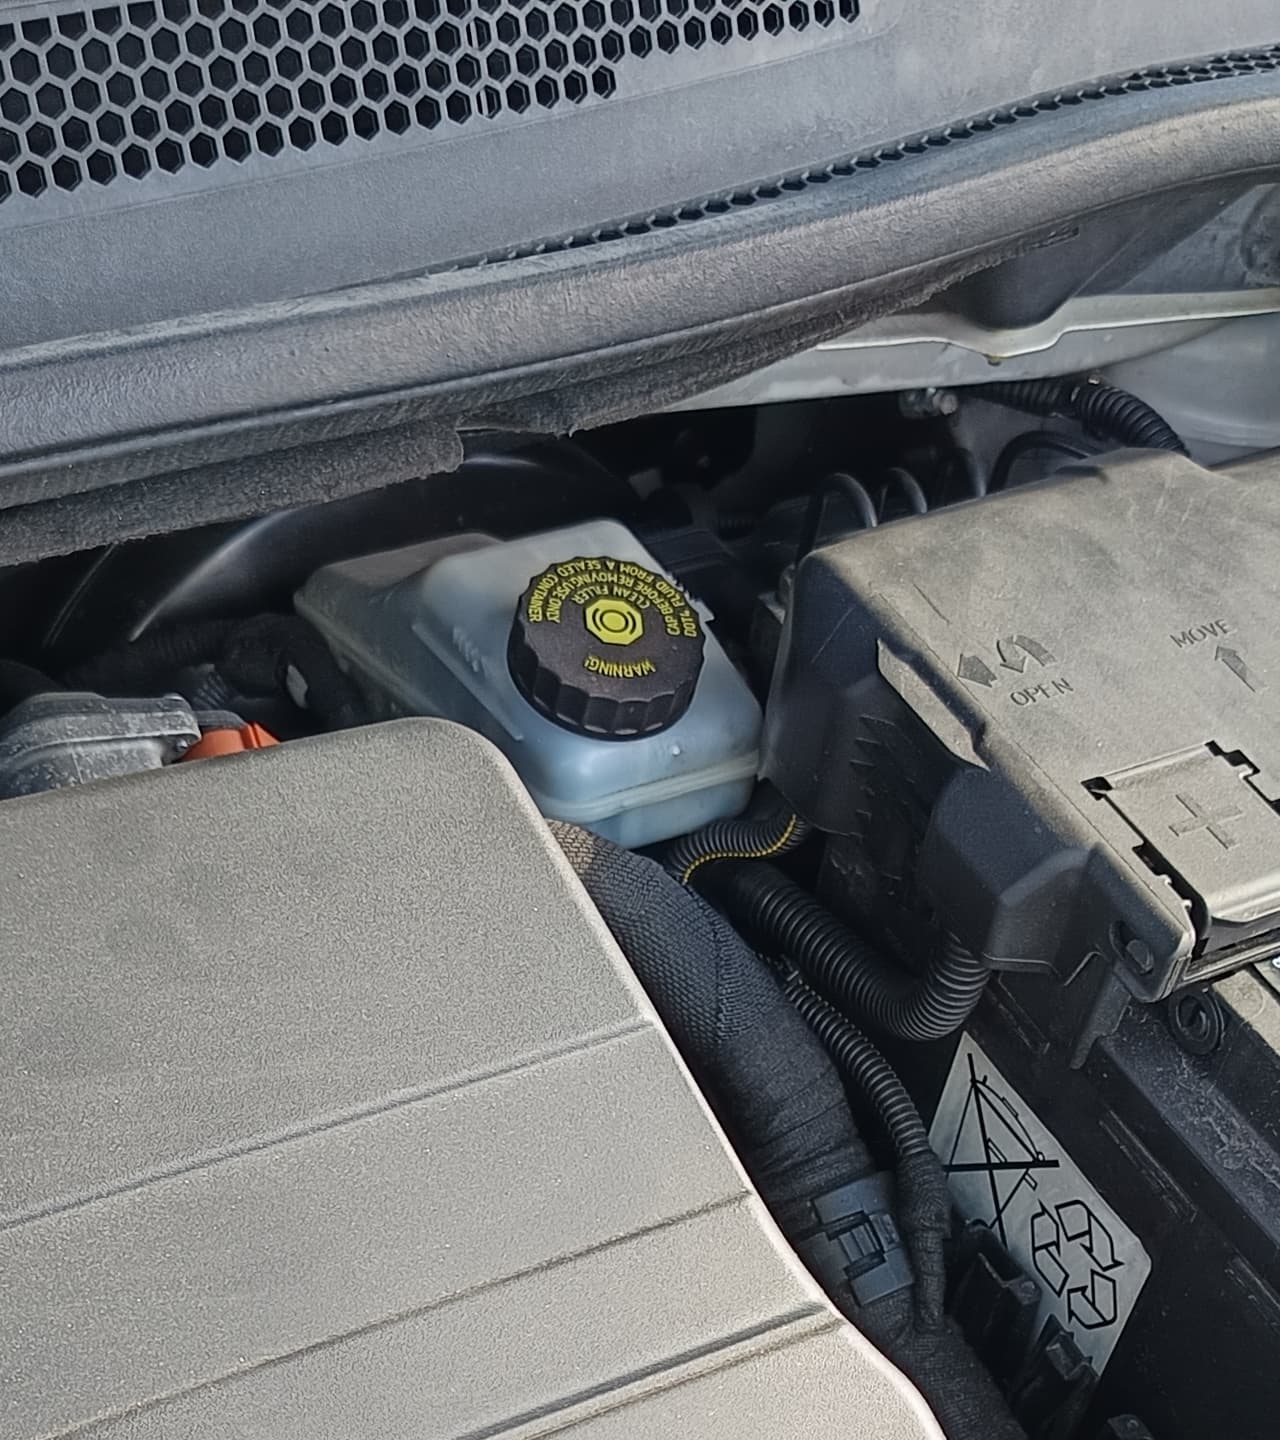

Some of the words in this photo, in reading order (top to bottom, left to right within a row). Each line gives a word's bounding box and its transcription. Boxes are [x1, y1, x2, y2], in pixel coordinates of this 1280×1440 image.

[557, 559, 602, 578] SEALED
[620, 563, 655, 583] FROM
[571, 572, 636, 593] REMOVING
[572, 584, 609, 605] FILLER
[655, 581, 685, 608] FLUID
[527, 574, 558, 623] CONTAINER
[612, 586, 651, 609] CLEAN
[635, 583, 674, 617] BEFORE
[546, 597, 562, 624] ONLY
[1171, 617, 1230, 649] MOVE
[584, 655, 656, 678] WARNING!
[1011, 677, 1071, 708] OPEN
